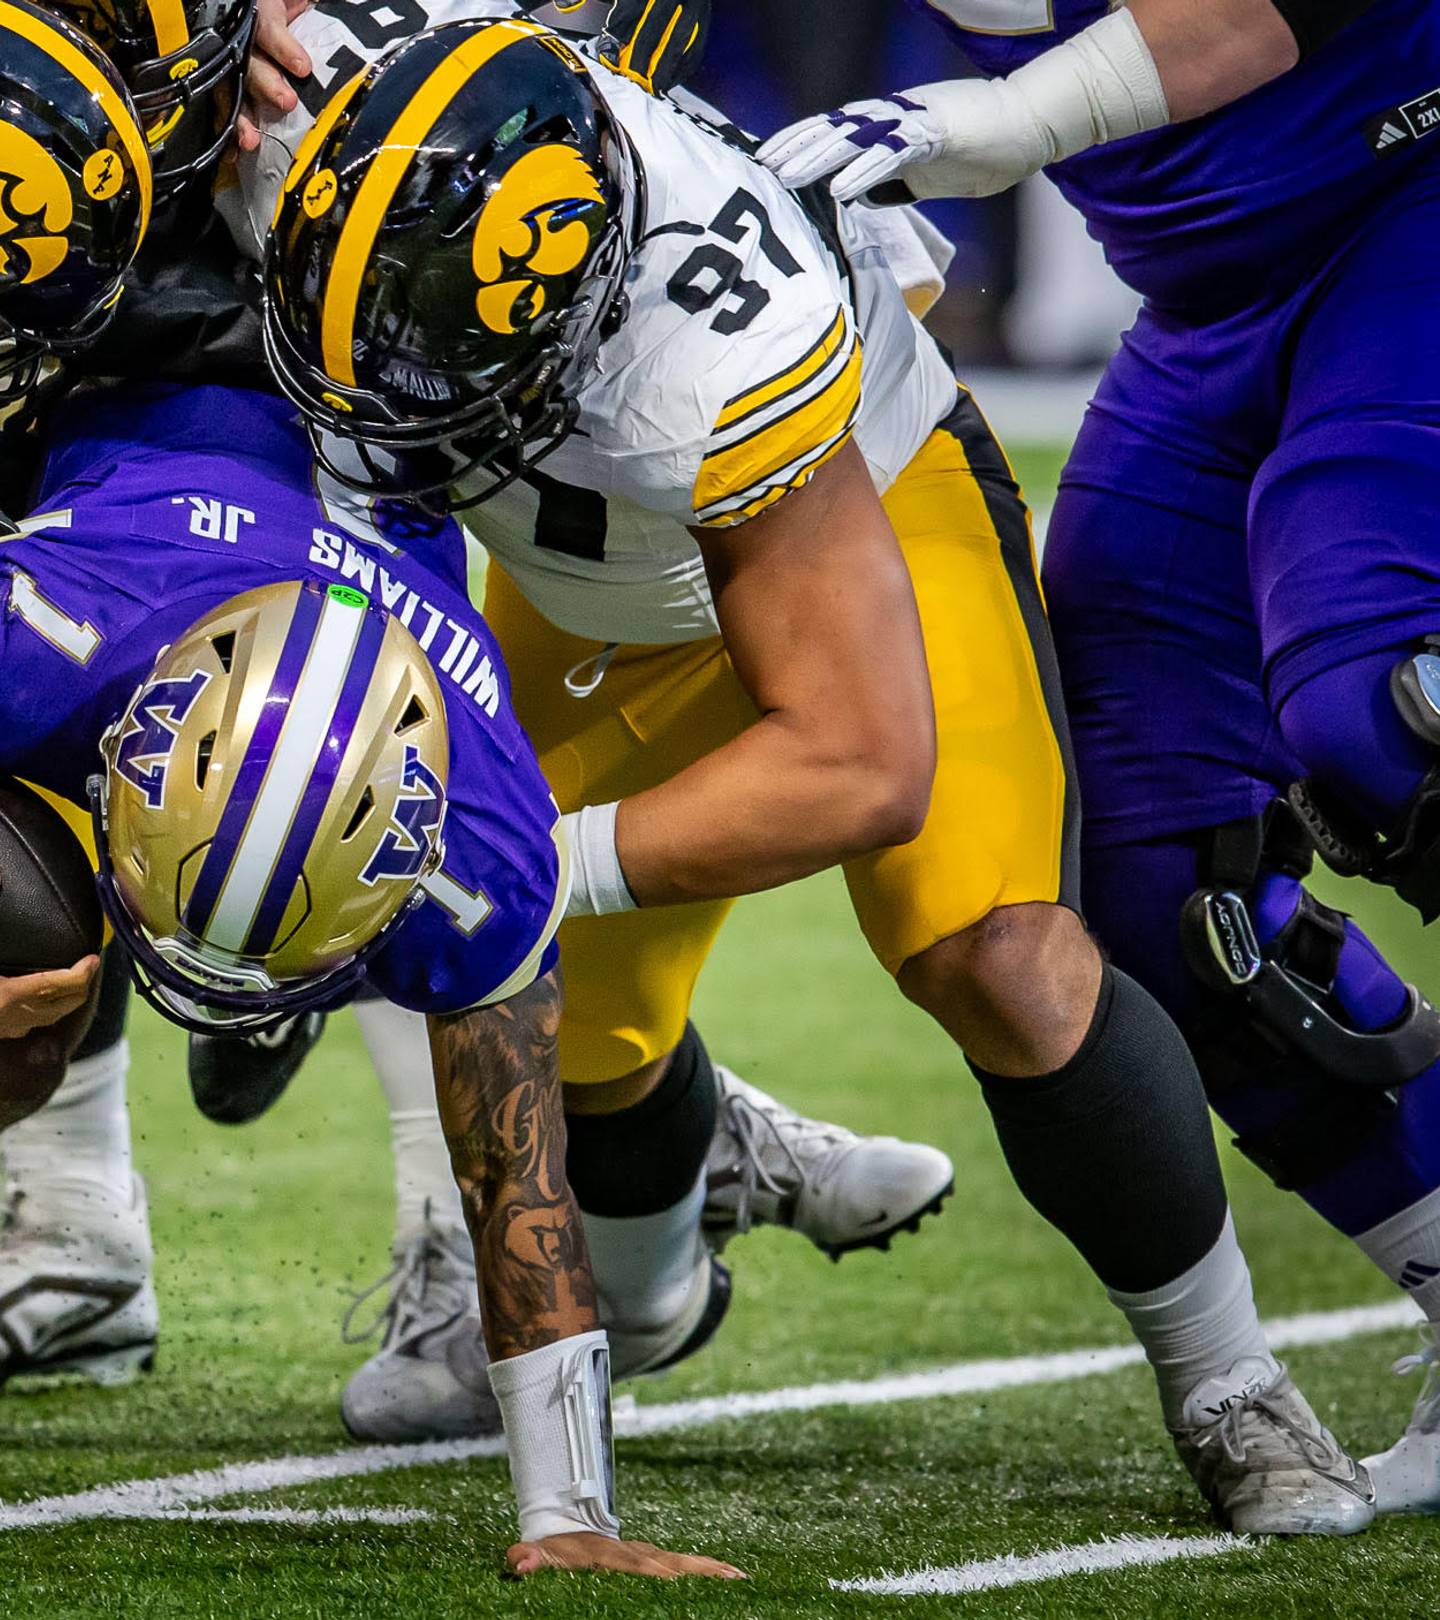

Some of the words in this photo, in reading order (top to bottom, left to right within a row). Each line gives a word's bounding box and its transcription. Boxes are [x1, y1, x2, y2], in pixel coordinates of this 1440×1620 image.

[666, 187, 807, 336] 97
[171, 497, 256, 544] JR.
[9, 570, 101, 667] 1
[309, 528, 500, 719] WILLIAMS
[115, 668, 214, 810] W
[358, 743, 446, 887] W
[417, 870, 494, 936] 1
